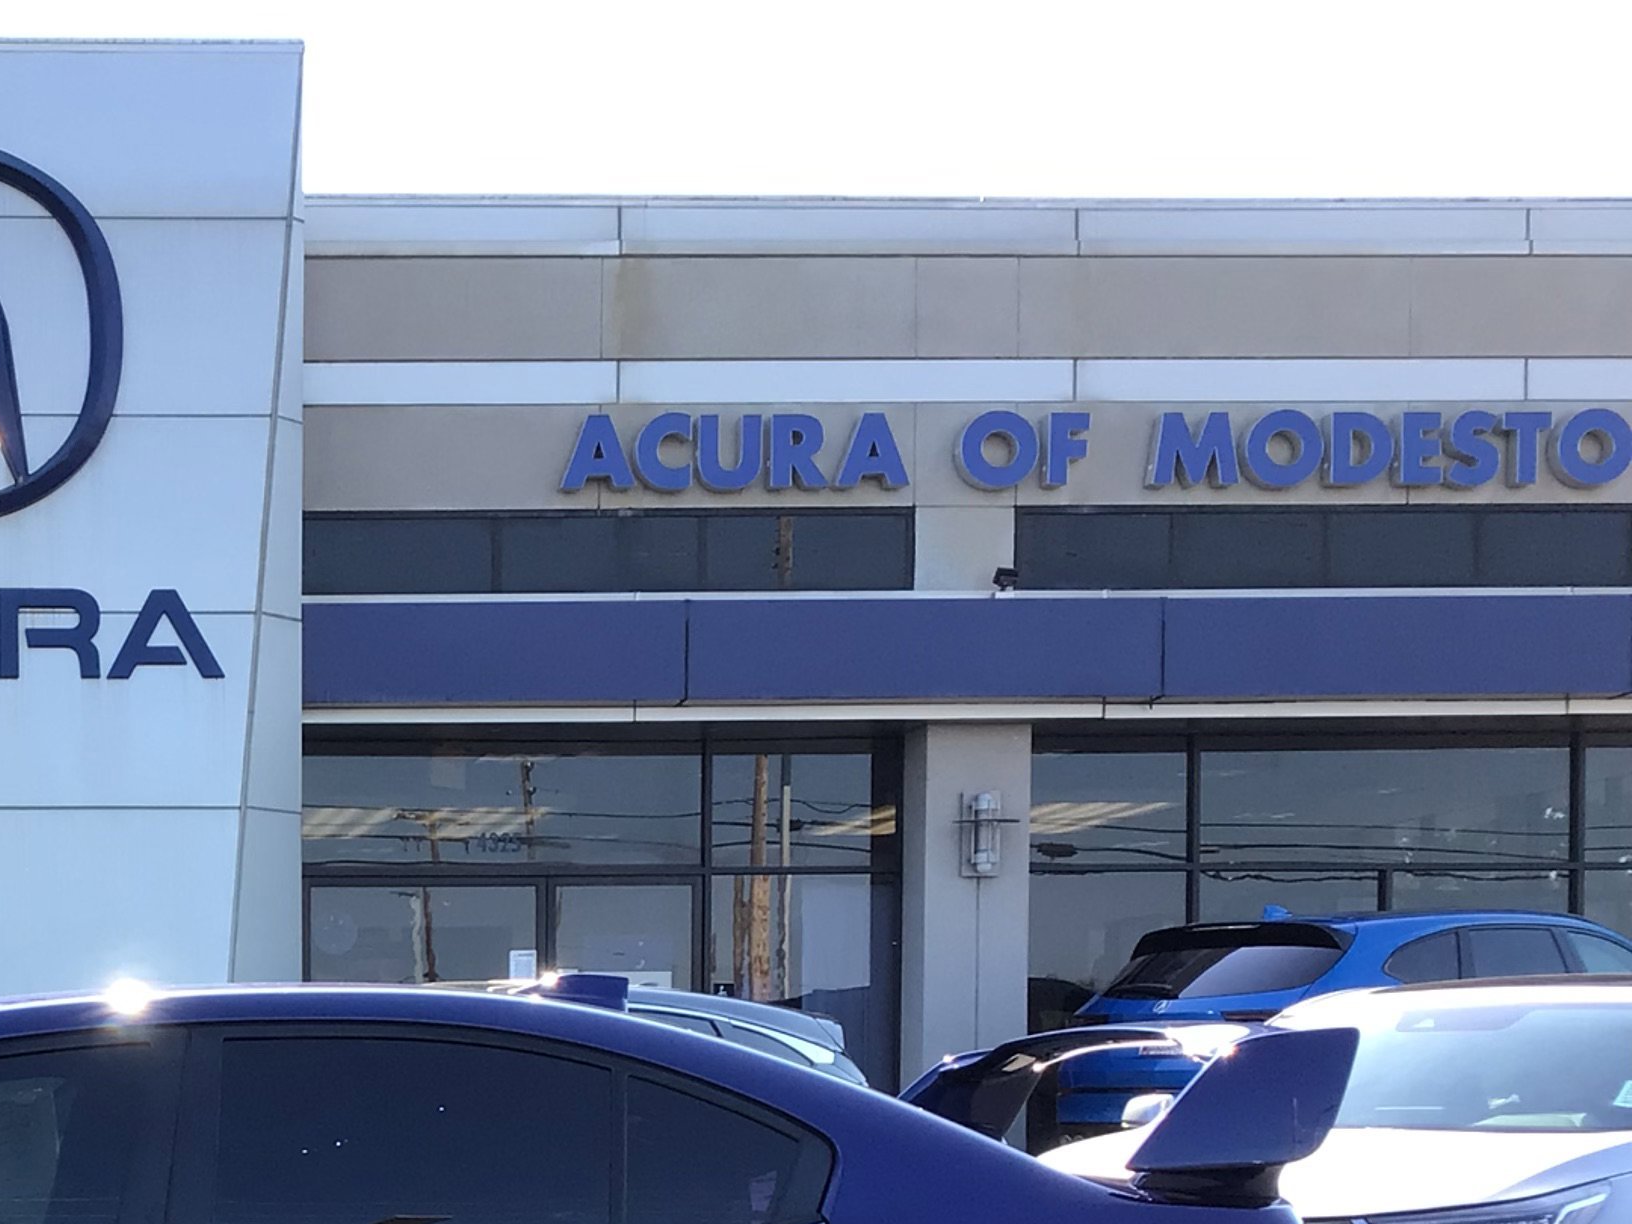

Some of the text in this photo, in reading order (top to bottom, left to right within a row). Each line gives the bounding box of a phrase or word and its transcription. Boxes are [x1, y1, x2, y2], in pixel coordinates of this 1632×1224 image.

[562, 408, 1632, 493] ACURA OF MODESTO
